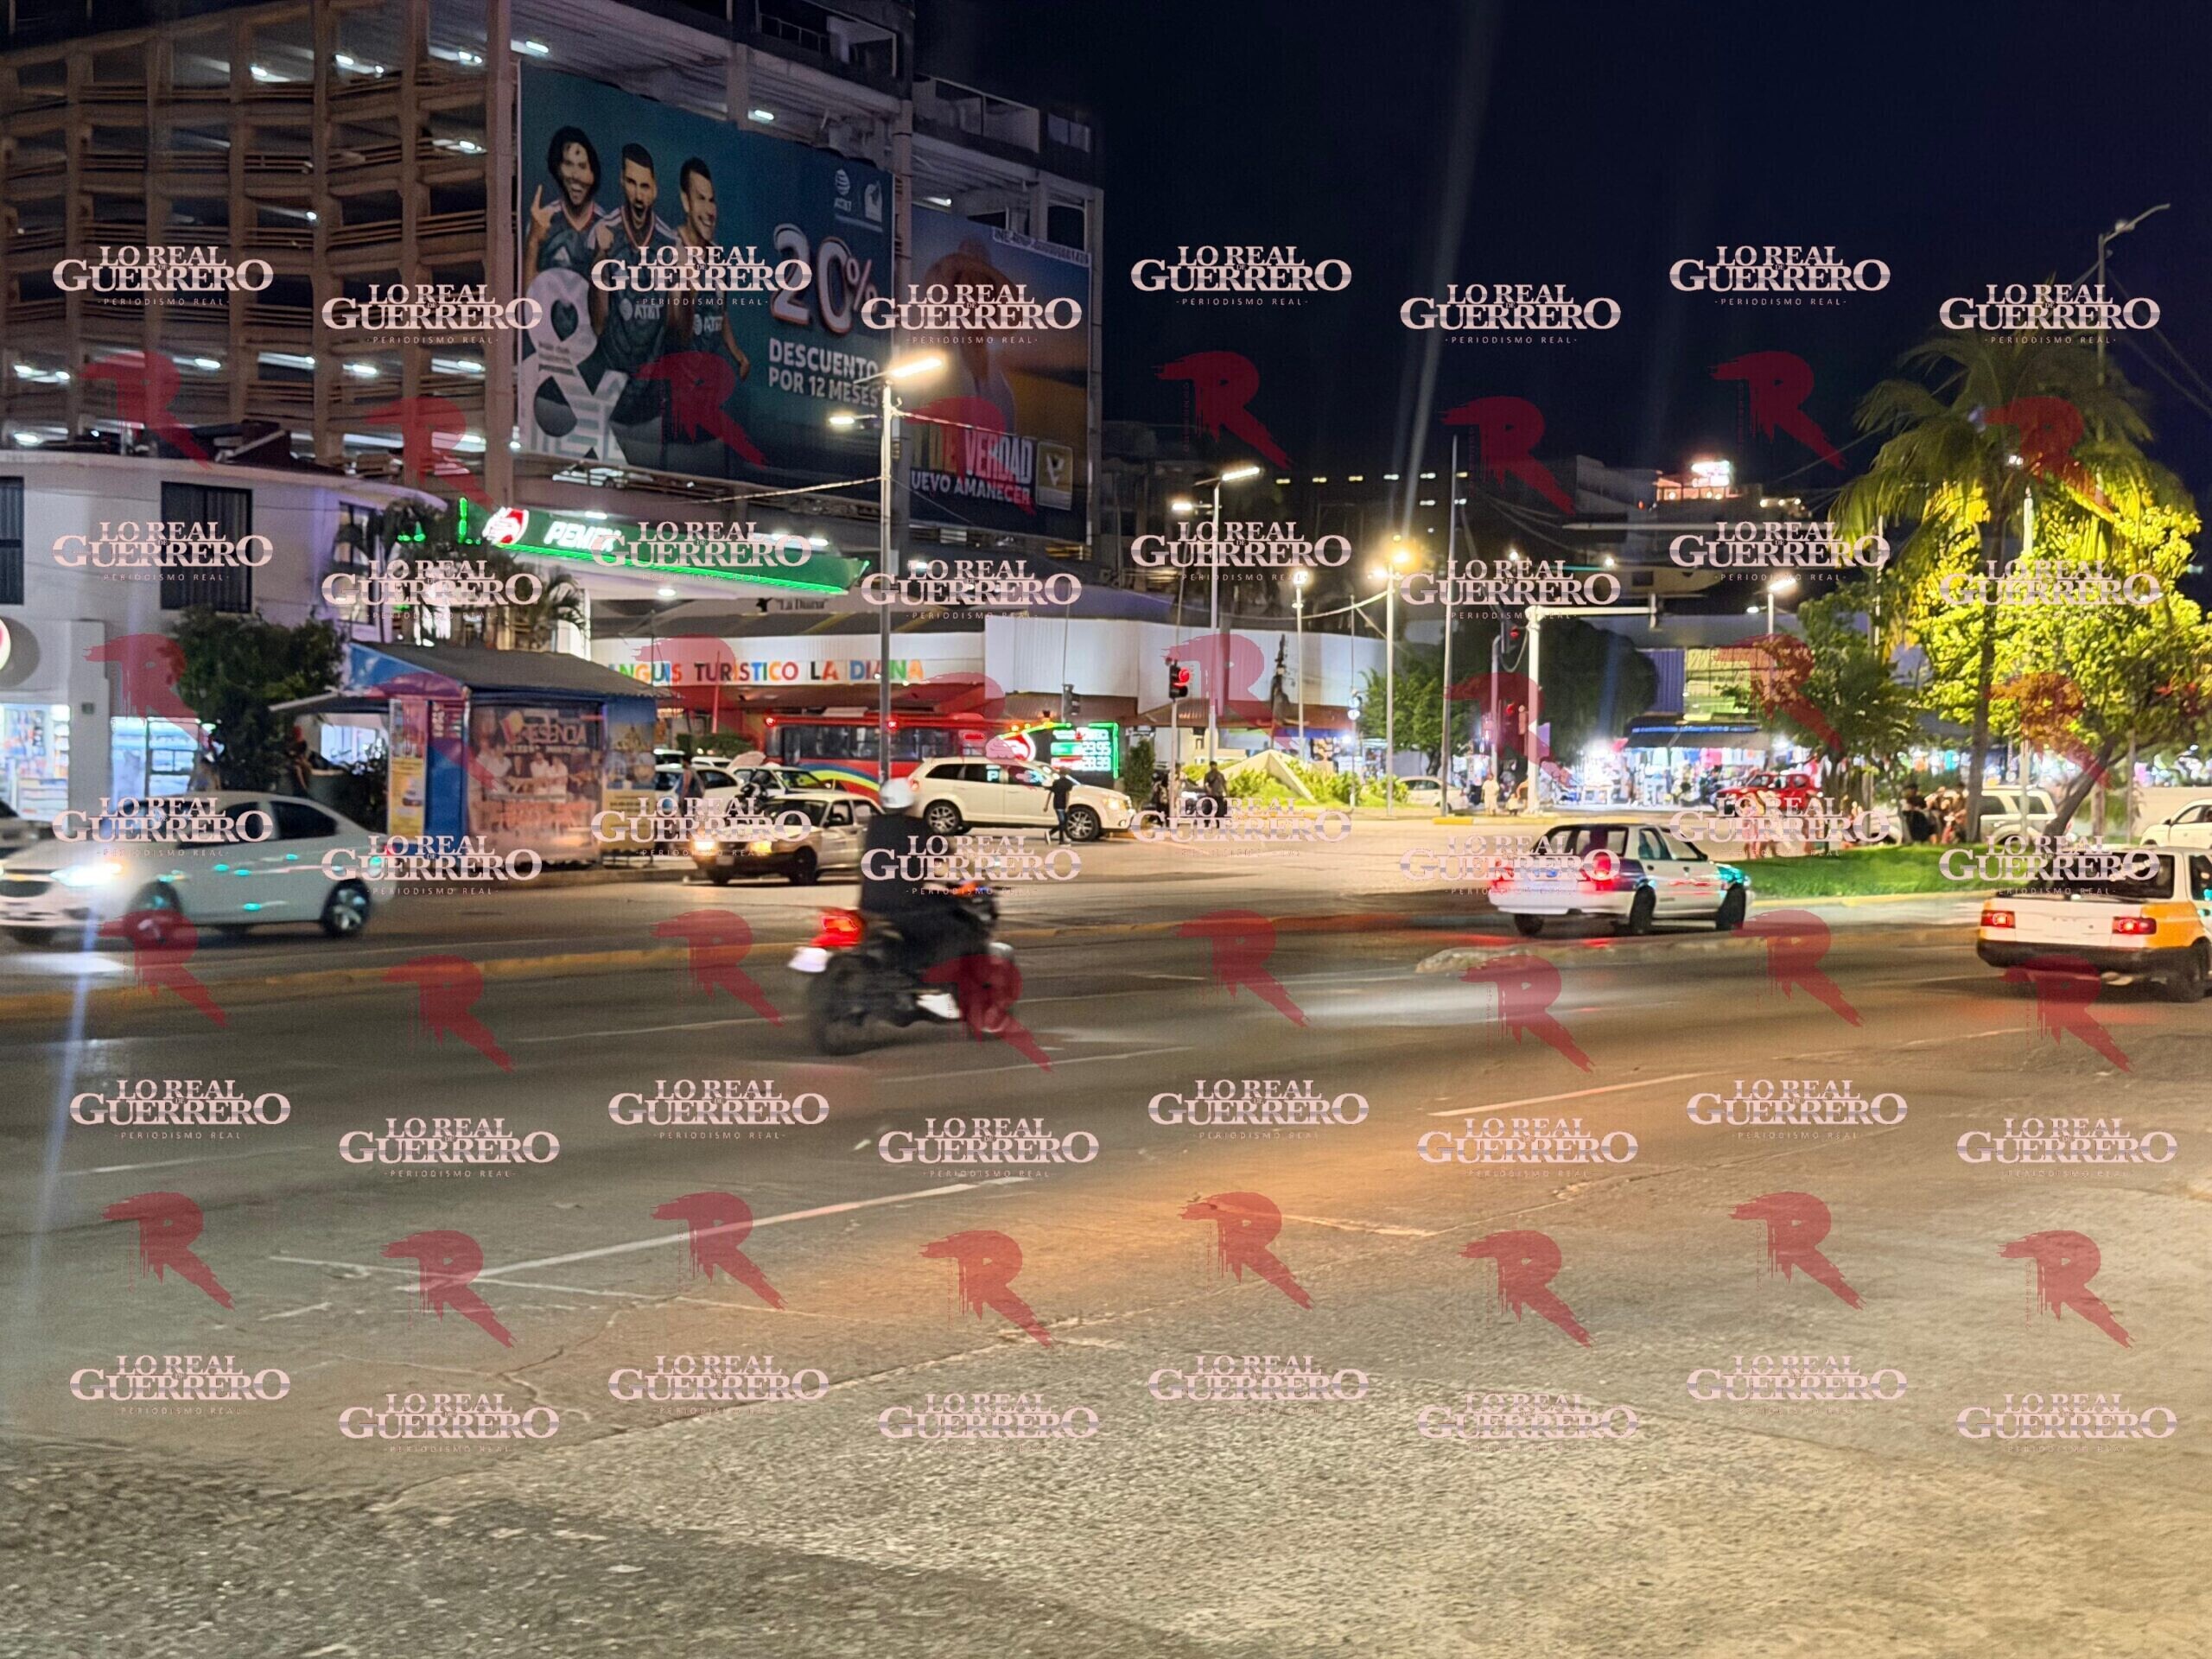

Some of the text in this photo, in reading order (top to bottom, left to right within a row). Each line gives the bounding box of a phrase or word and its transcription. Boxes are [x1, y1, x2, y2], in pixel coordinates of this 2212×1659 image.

[768, 337, 879, 381] DESCUENTO
[768, 366, 879, 408] POR 12 MESES
[964, 429, 1033, 485] VERDAD
[911, 470, 1032, 505] UEVO AMANECER
[608, 662, 683, 682] NGUIS
[694, 661, 799, 682] TURISTICO
[810, 660, 839, 681] LA
